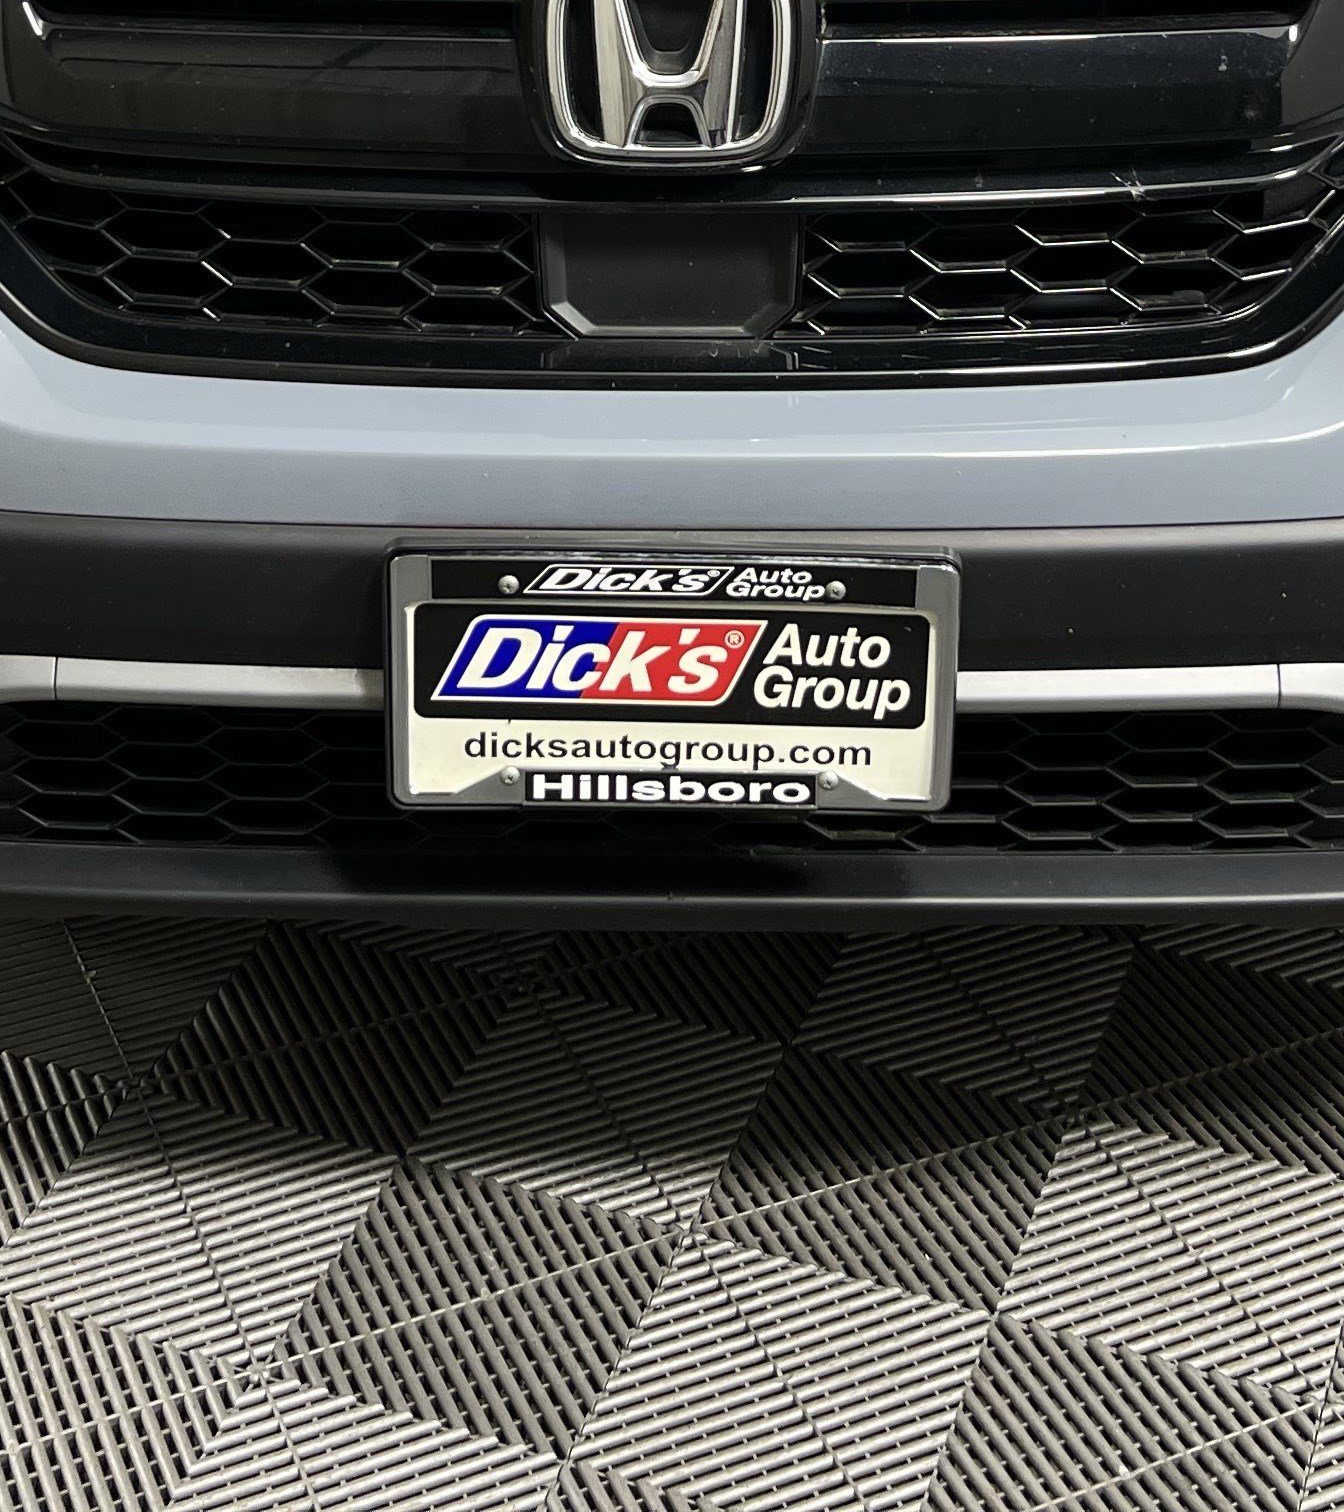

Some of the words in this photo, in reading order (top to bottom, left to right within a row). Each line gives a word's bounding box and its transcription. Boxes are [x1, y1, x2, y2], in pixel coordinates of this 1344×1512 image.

[726, 581, 826, 601] Group
[733, 567, 813, 584] Auto
[763, 623, 891, 669] Auto
[754, 665, 911, 720] Group
[464, 731, 872, 769] dicksautogroup.com
[532, 773, 811, 804] Hillsboro
